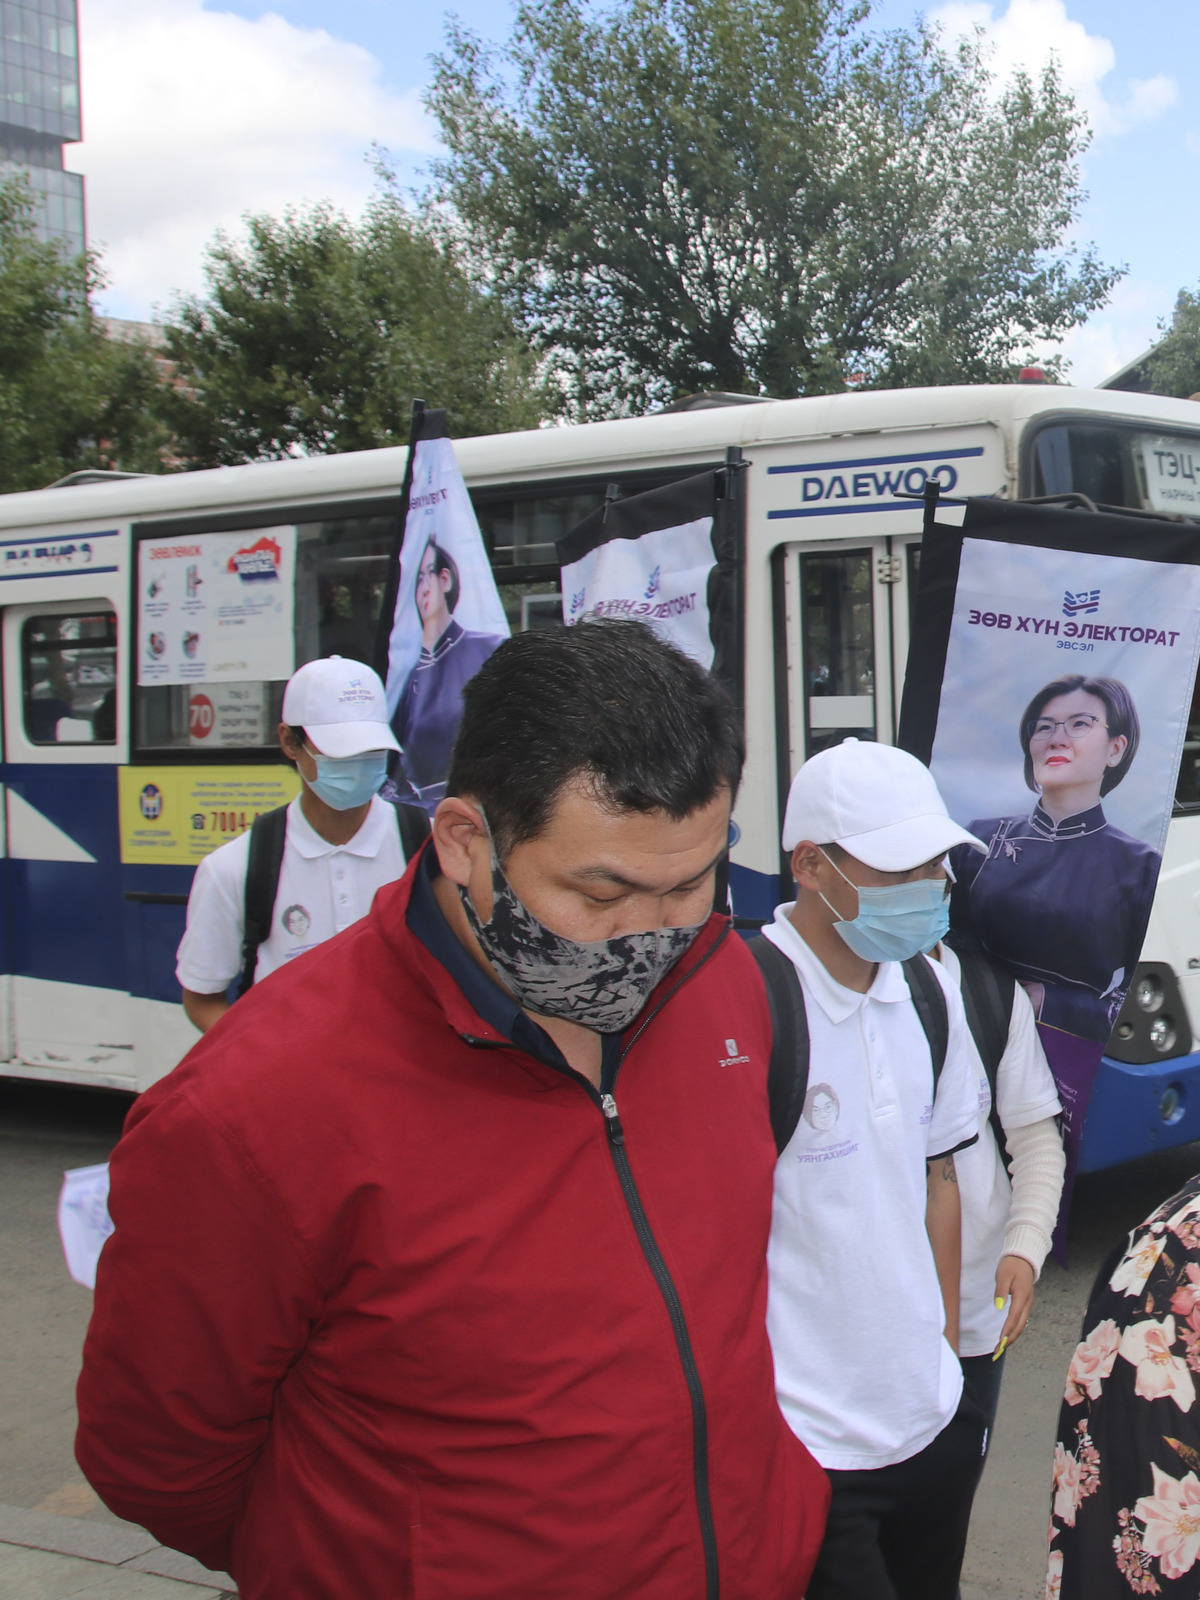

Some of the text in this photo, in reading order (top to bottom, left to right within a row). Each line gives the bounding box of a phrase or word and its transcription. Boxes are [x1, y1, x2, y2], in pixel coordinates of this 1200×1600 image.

[802, 464, 958, 502] DAEWOO
[968, 609, 1180, 647] ЗӨВ ХҮН ЭЛЕКТОРАТ
[1056, 640, 1094, 652] ЭВСЭЛ
[190, 704, 212, 728] 70
[211, 812, 260, 832] 7004-
